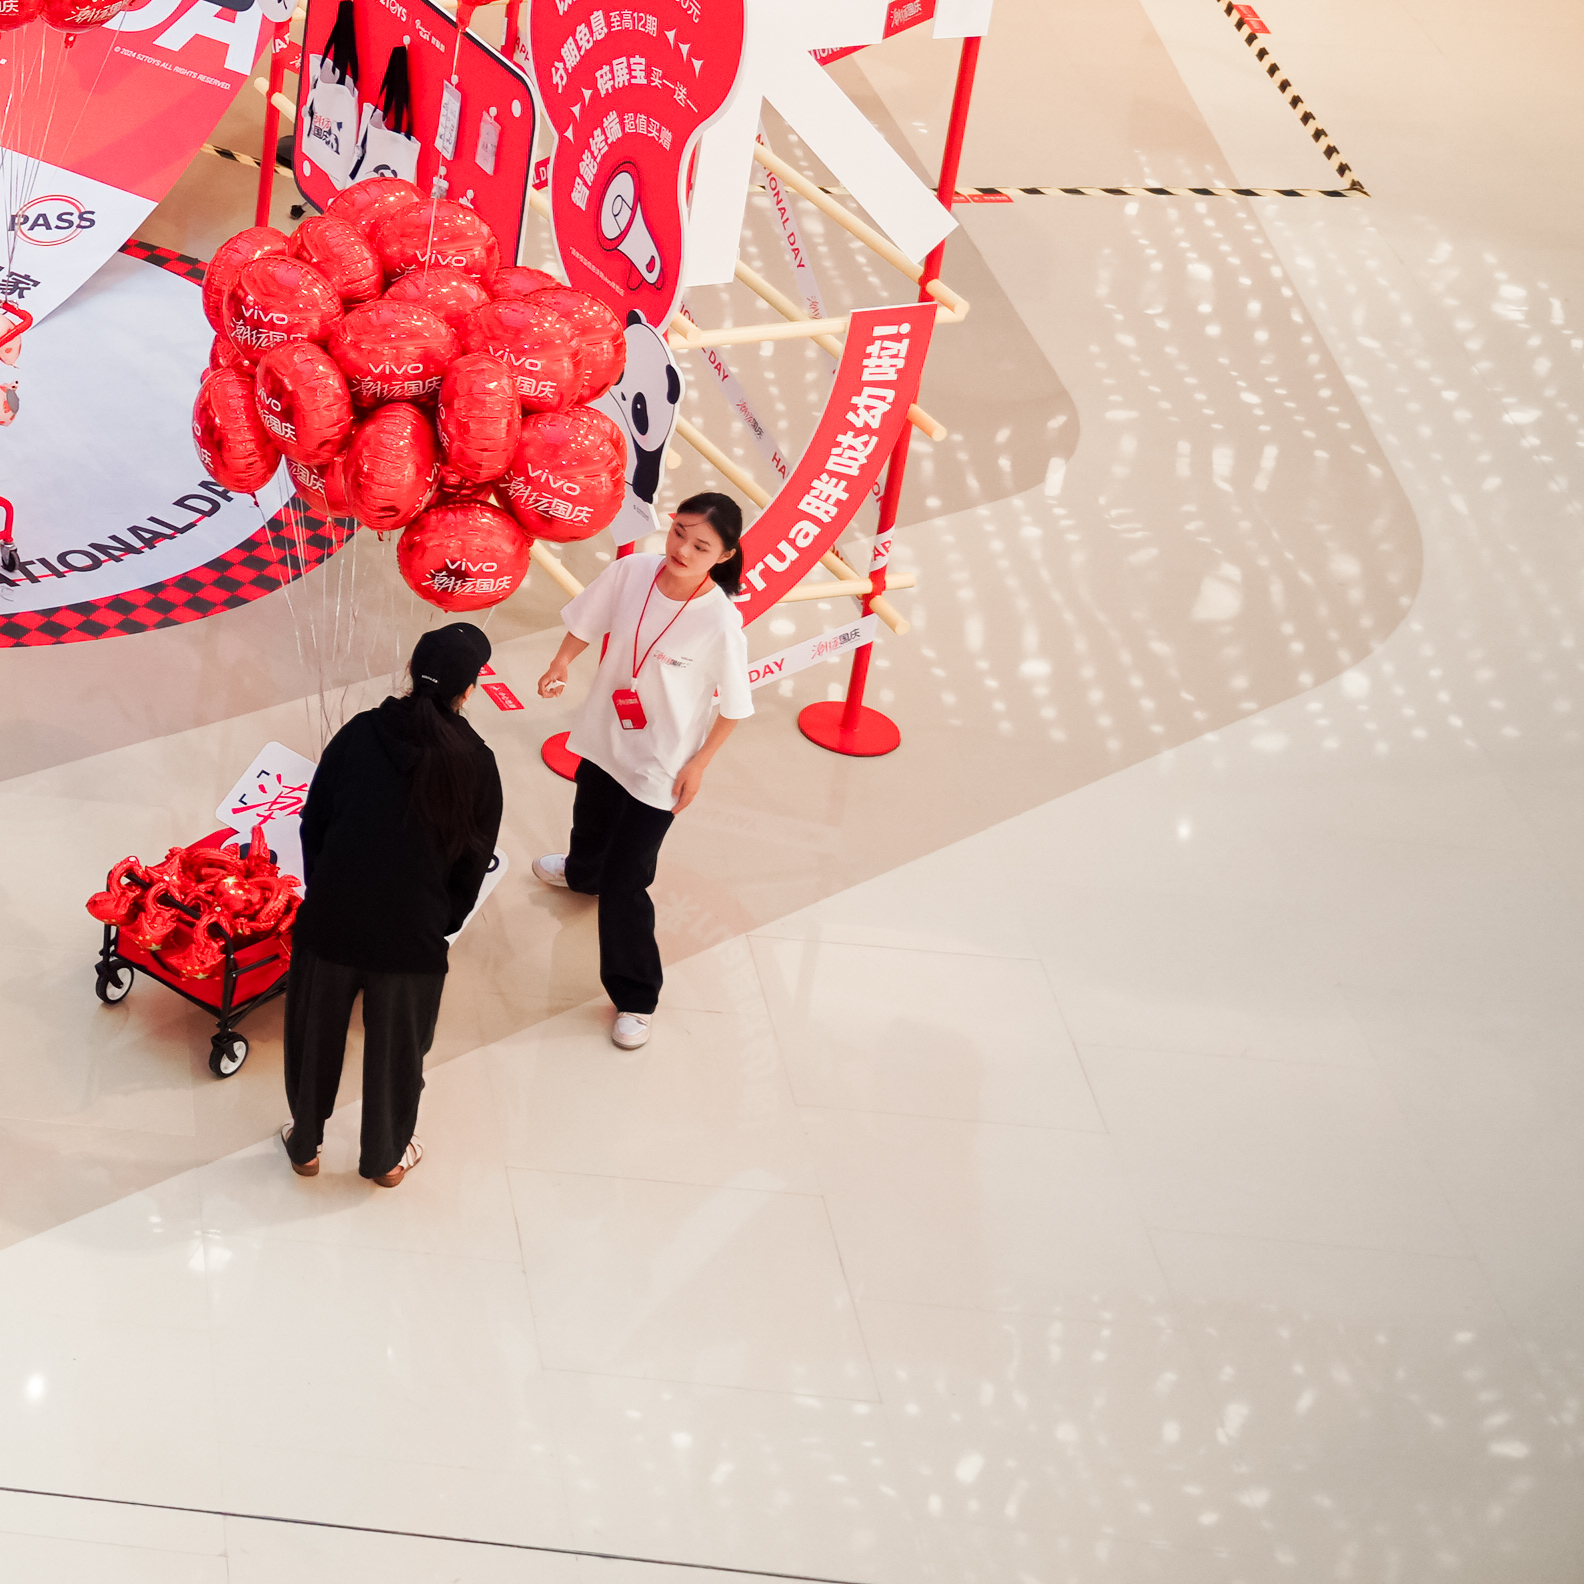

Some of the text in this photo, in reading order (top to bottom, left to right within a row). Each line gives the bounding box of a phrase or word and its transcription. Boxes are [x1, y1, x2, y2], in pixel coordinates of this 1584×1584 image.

[551, 9, 658, 94] 分期免息 至高12期
[173, 64, 198, 80] RIGHTS
[595, 55, 699, 114] 碎屏宝 买一送一
[571, 110, 673, 212] 智能终端 超值买赠
[7, 211, 96, 232] PASS
[416, 250, 466, 267] vivo
[786, 230, 806, 270] DAY
[240, 305, 288, 324] vivo
[368, 361, 423, 375] vivo
[488, 346, 541, 371] vivo
[708, 350, 729, 383] DAY
[257, 386, 281, 412] vivo
[527, 463, 580, 496] vivo
[445, 557, 497, 573] vivo
[748, 657, 785, 684] DAY
